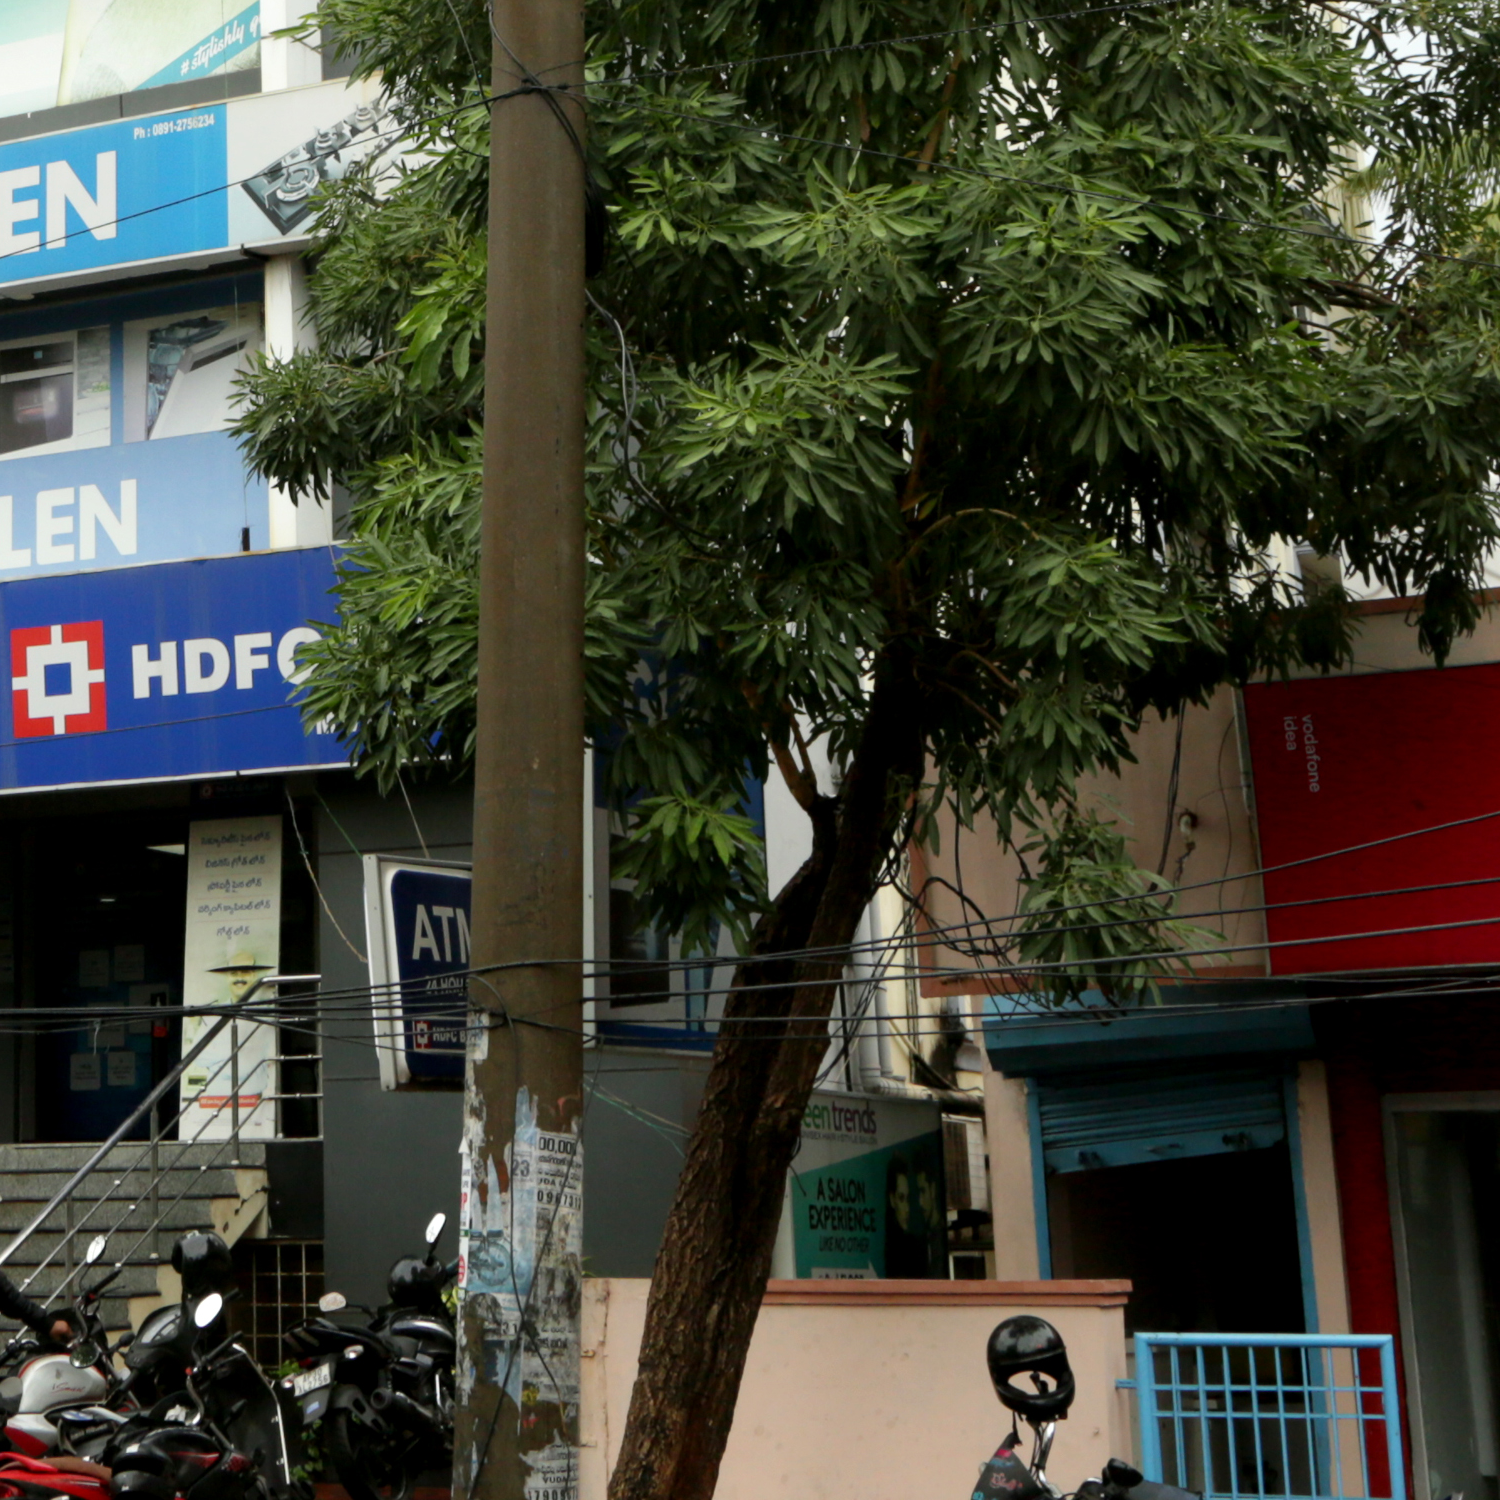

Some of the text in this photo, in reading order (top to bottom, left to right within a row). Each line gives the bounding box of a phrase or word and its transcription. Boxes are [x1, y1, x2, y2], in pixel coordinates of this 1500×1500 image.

[131, 626, 324, 700] HDFC
[1283, 715, 1298, 751] idea
[1302, 714, 1321, 793] vodafone
[801, 1100, 877, 1135] een trends
[817, 1177, 866, 1204] A SALON
[809, 1204, 877, 1233] EXPERIENCE
[819, 1236, 870, 1253] LIKE NO OTHER
